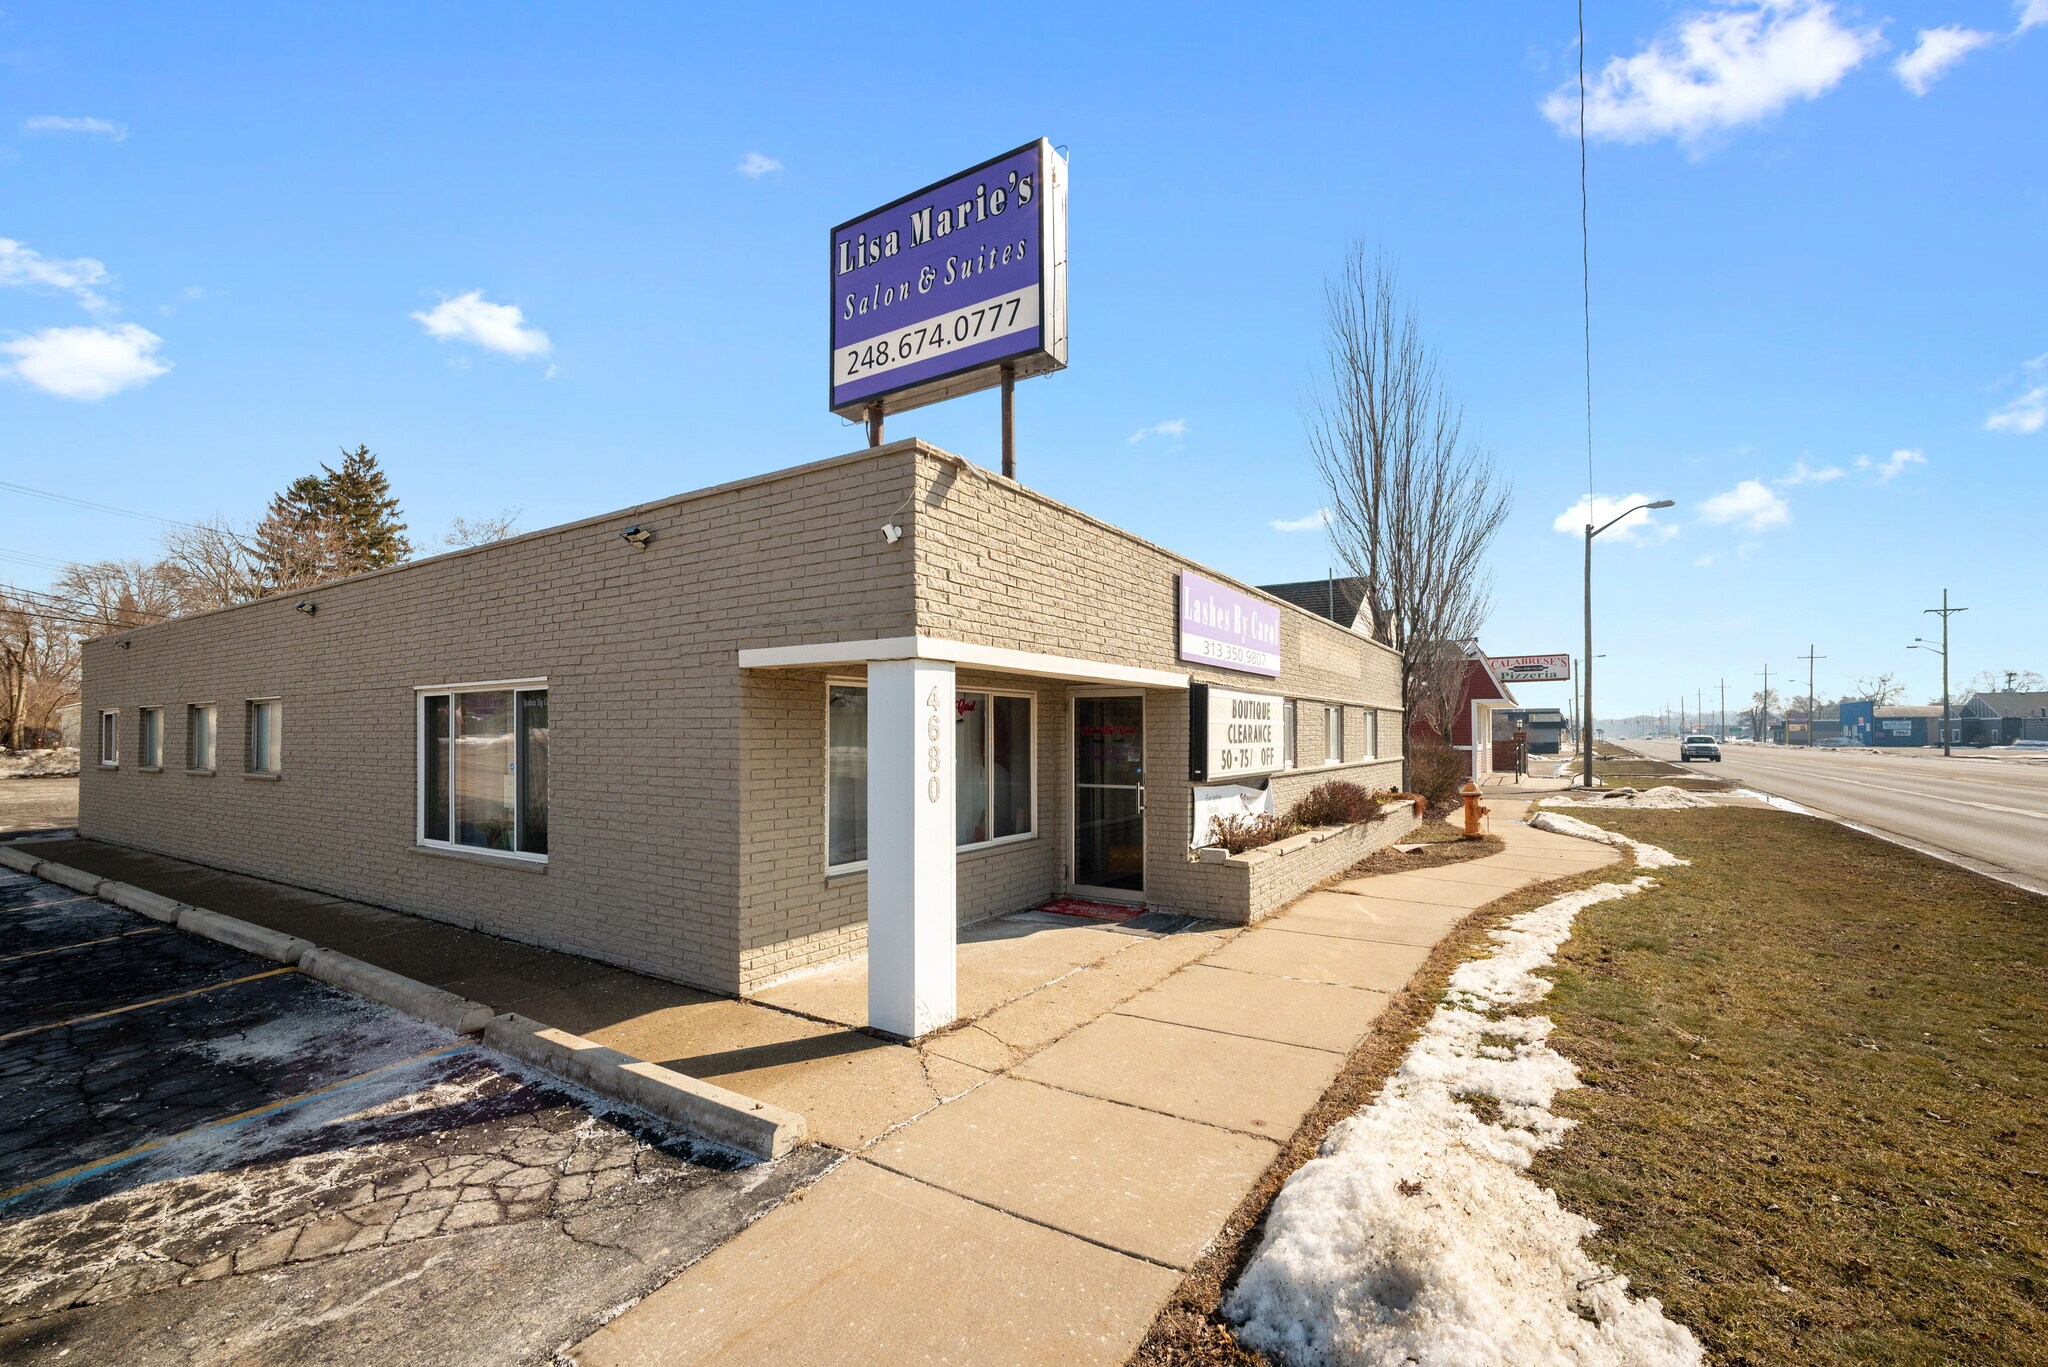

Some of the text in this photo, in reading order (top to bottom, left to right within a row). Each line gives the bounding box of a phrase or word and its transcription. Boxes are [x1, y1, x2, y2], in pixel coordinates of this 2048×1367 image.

[838, 170, 1035, 276] Lisa Marie's
[844, 239, 1027, 320] Salon & Suites
[847, 297, 1021, 376] 248.674.0777
[1184, 586, 1279, 646] Lashes By Carol
[1203, 640, 1267, 667] 313.350.9807
[1491, 657, 1567, 670] CALABRESE'S
[1501, 671, 1557, 680] Pizzeria
[1232, 699, 1271, 720] BOUTIQUE
[926, 684, 940, 803] 4680
[1228, 723, 1271, 744] CLEARANCE
[1261, 747, 1274, 766] OFF
